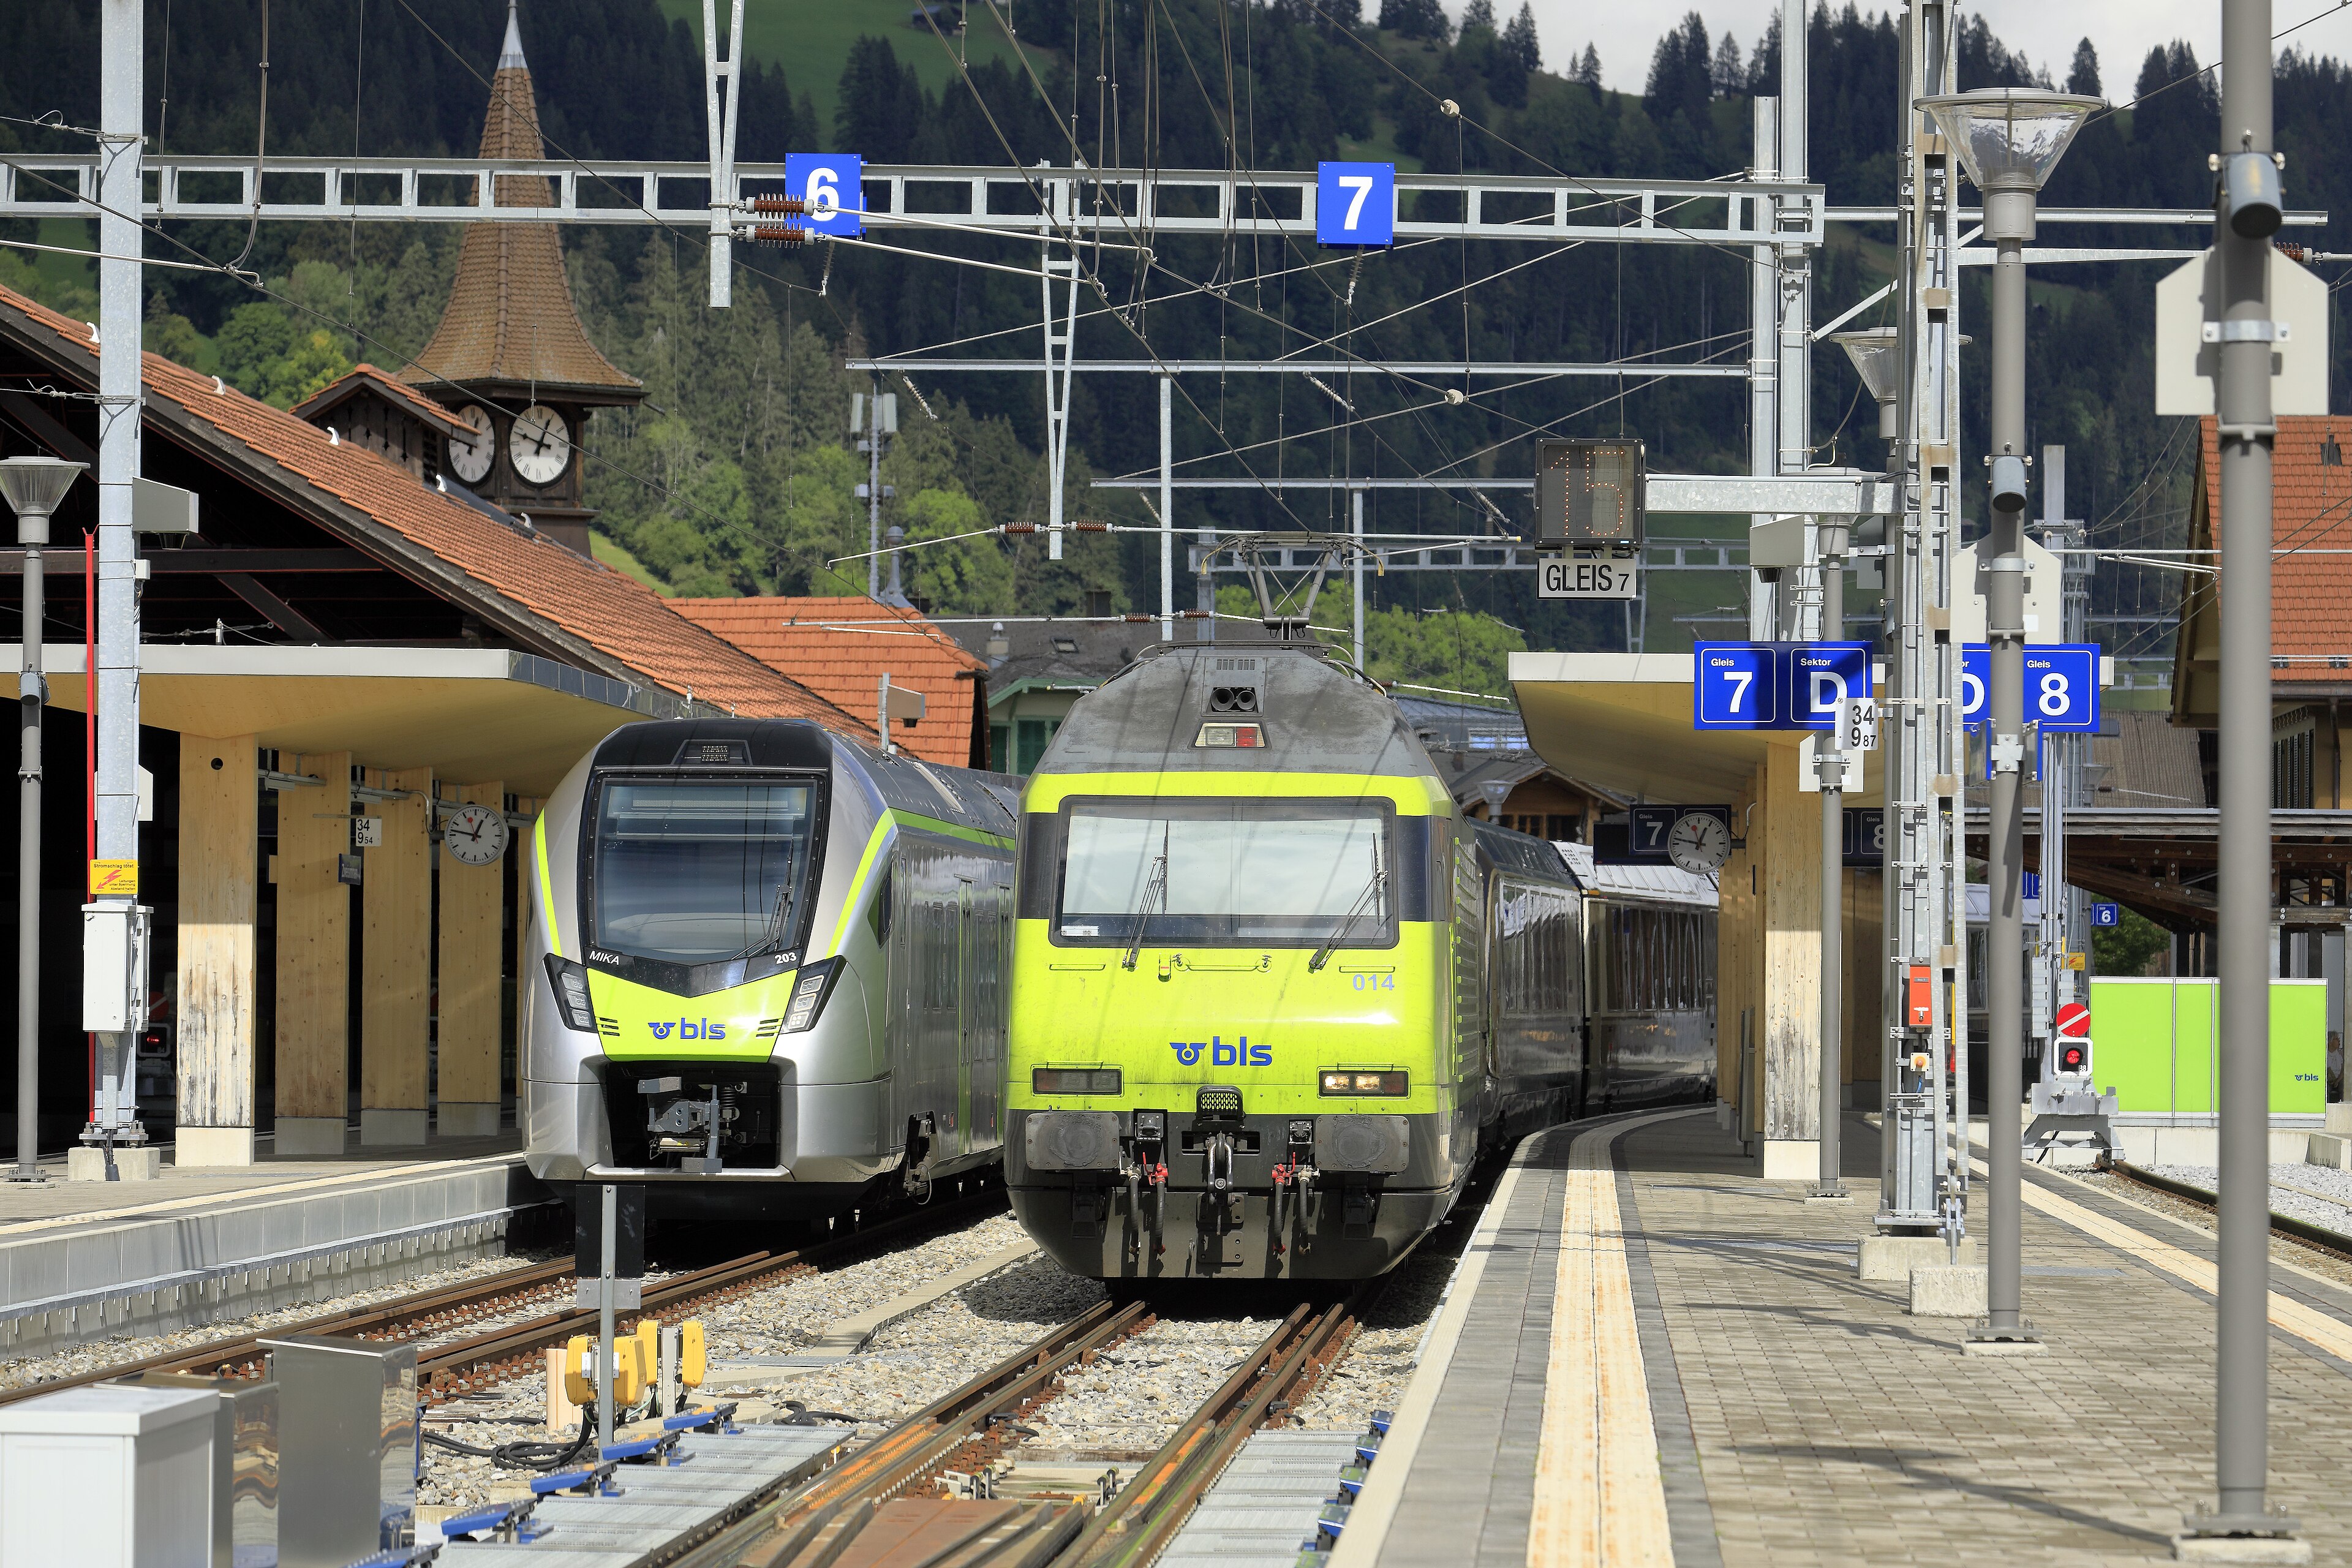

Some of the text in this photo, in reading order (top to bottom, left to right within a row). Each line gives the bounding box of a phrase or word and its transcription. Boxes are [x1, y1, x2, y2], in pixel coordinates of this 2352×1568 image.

[806, 167, 839, 221] 6
[1339, 176, 1373, 230] 7
[1550, 451, 1626, 536] 15
[1546, 564, 1630, 592] GLEIS 7
[1710, 658, 1735, 667] Gleis
[1800, 657, 1832, 666] Sektor
[2027, 660, 2051, 669] Gleis
[1724, 671, 1753, 713] 7
[1810, 671, 1848, 713] D
[2038, 672, 2071, 716] 8
[1852, 705, 1874, 725] 34
[357, 819, 370, 831] 34
[1646, 821, 1664, 846] 7
[1873, 824, 1884, 850] 8
[2101, 910, 2111, 923] 6
[589, 951, 620, 965] MIKA
[774, 952, 797, 965] 203
[1352, 974, 1395, 991] 014
[680, 1017, 726, 1040] bls
[1212, 1036, 1273, 1066] bls
